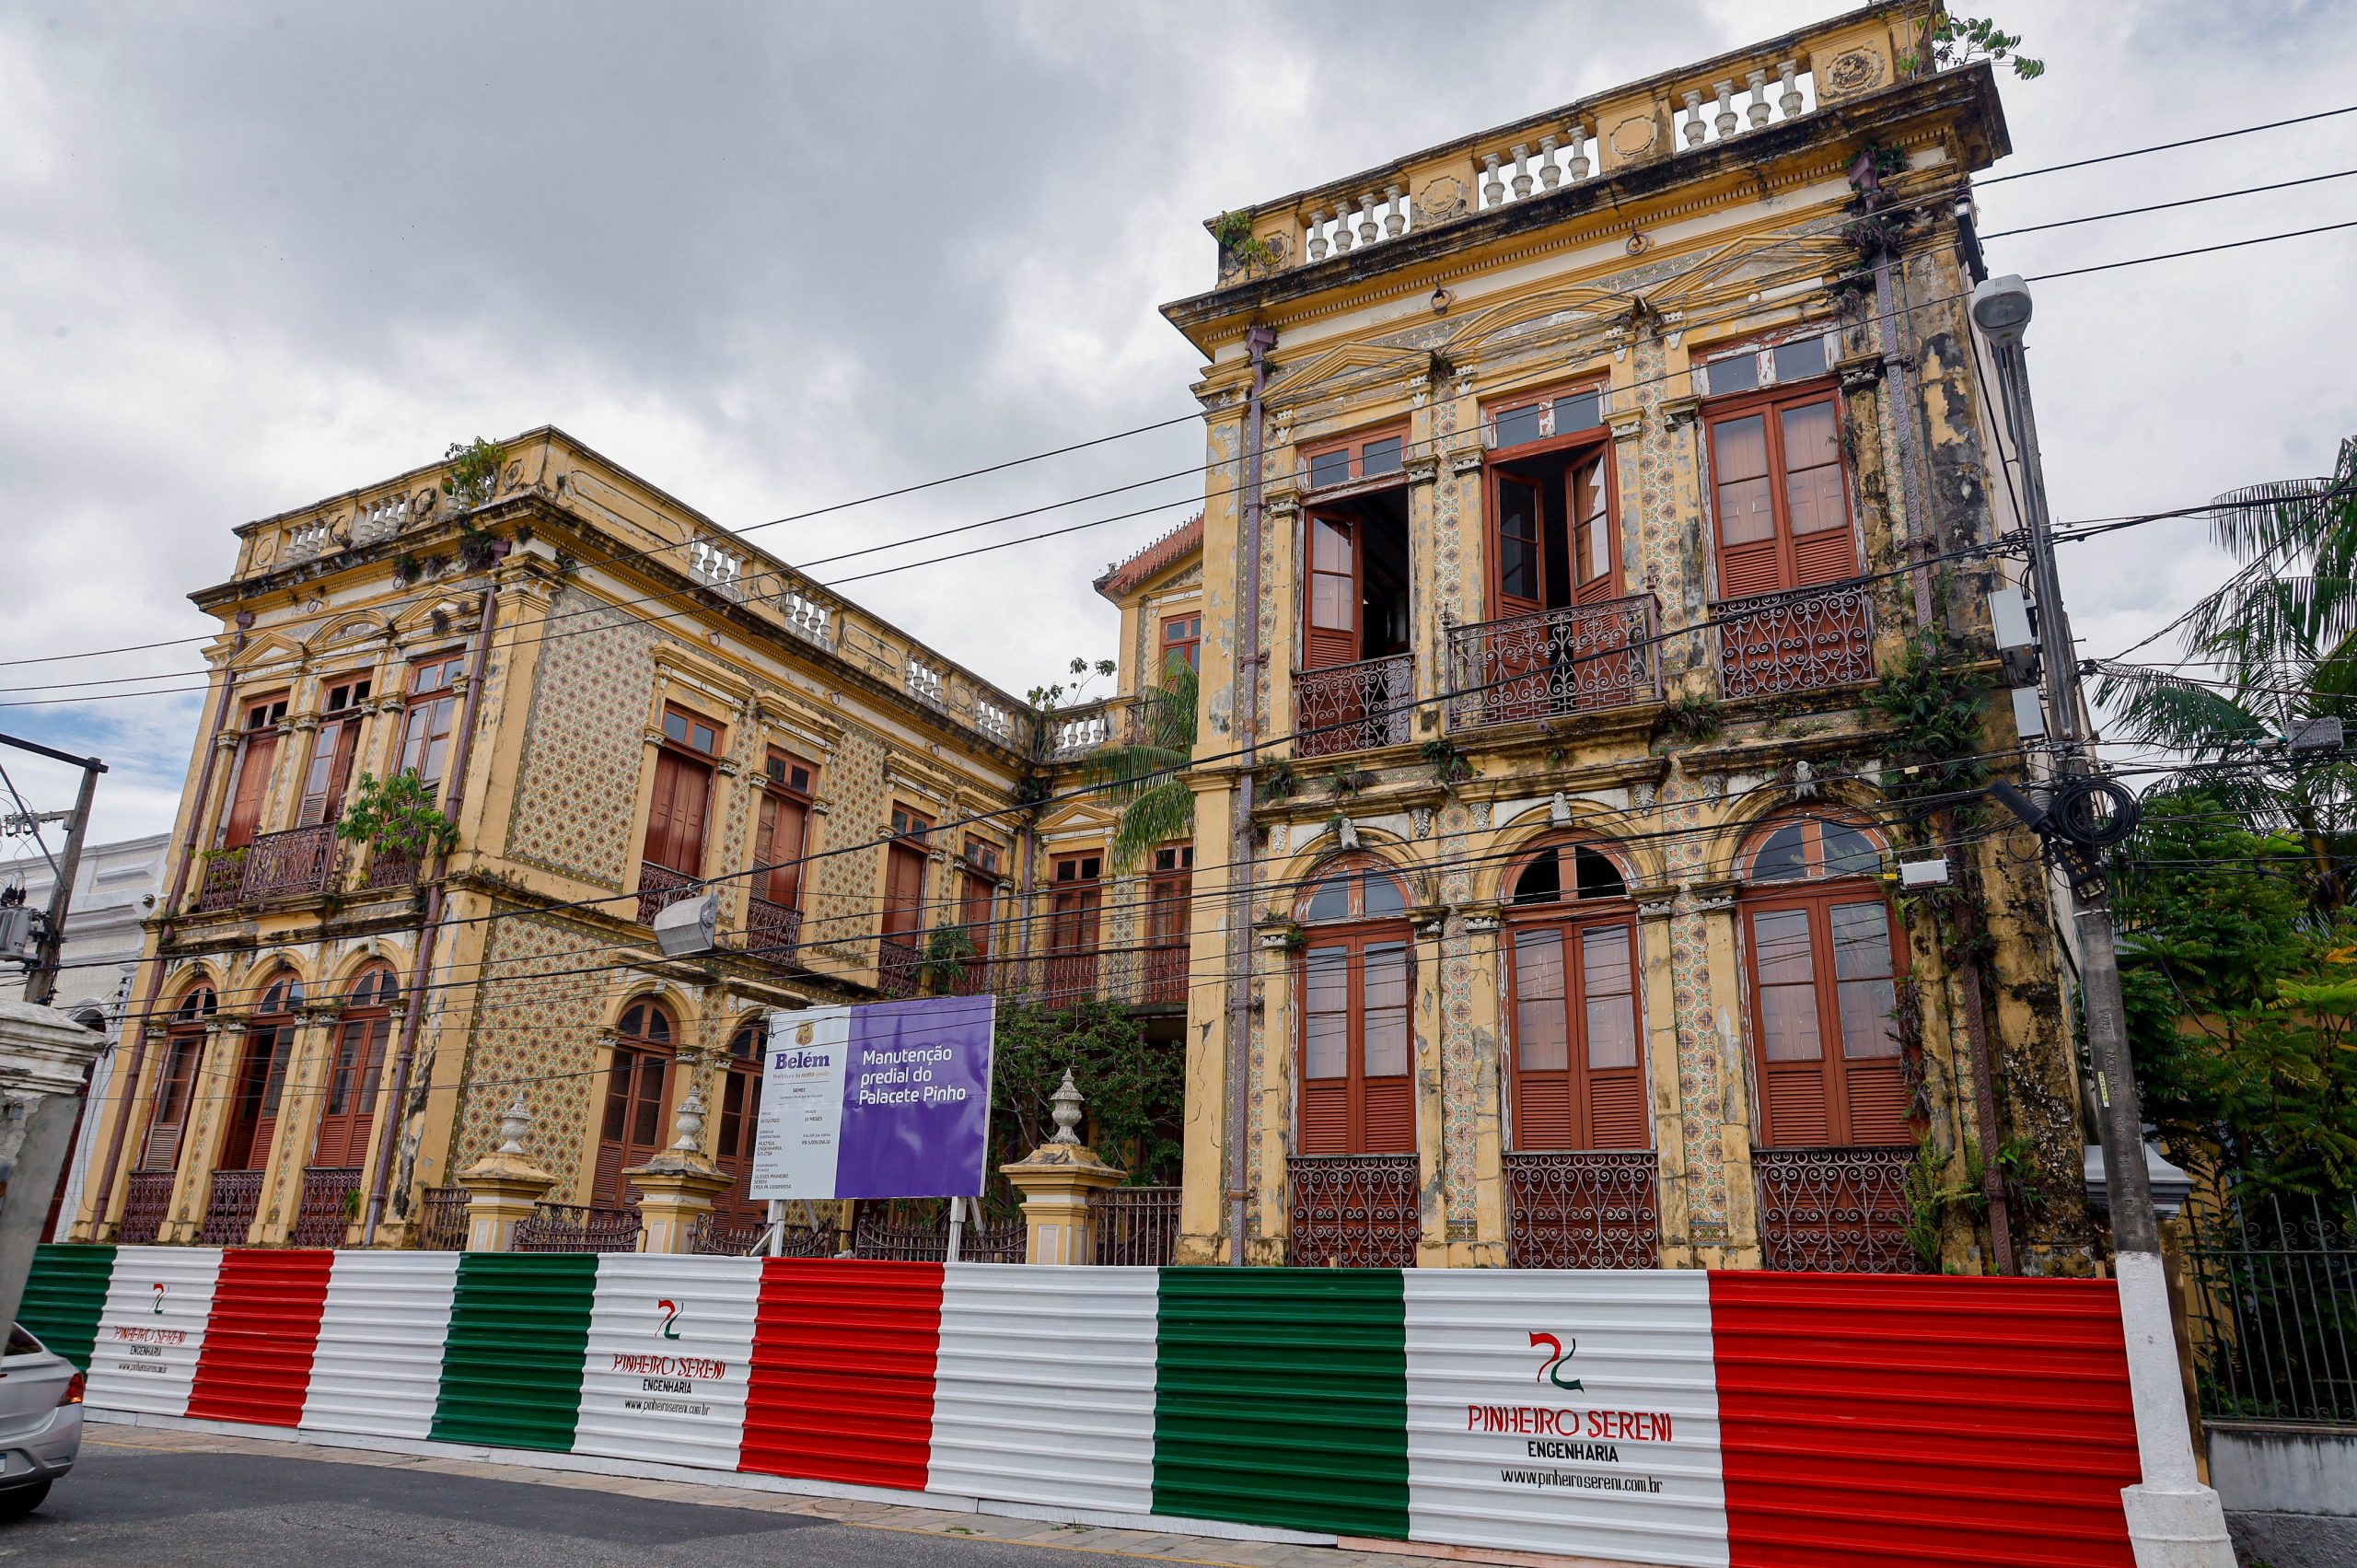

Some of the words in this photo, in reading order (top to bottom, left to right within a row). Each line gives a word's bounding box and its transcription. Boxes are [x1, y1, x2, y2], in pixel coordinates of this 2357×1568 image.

[774, 1051, 830, 1069] Belém
[863, 1045, 952, 1065] Manutenção
[861, 1066, 910, 1088] predial
[912, 1065, 932, 1082] do
[859, 1088, 920, 1105] Palacete
[923, 1085, 967, 1102] Pinho
[111, 1326, 155, 1342] PINHEIRO
[154, 1329, 187, 1345] SERENI
[130, 1345, 162, 1357] ENGENHARIA
[610, 1353, 676, 1376] PINHEIRO
[677, 1357, 726, 1380] SERENI
[643, 1378, 692, 1394] ENGENHARIA
[624, 1399, 711, 1416] www.pinheirosereni.com.br
[1467, 1404, 1580, 1436] PINHEIRO
[1586, 1409, 1673, 1443] SERENI
[1527, 1440, 1620, 1463] ENGENHARIA
[1500, 1469, 1664, 1493] www.pinheirosereni.com.br
